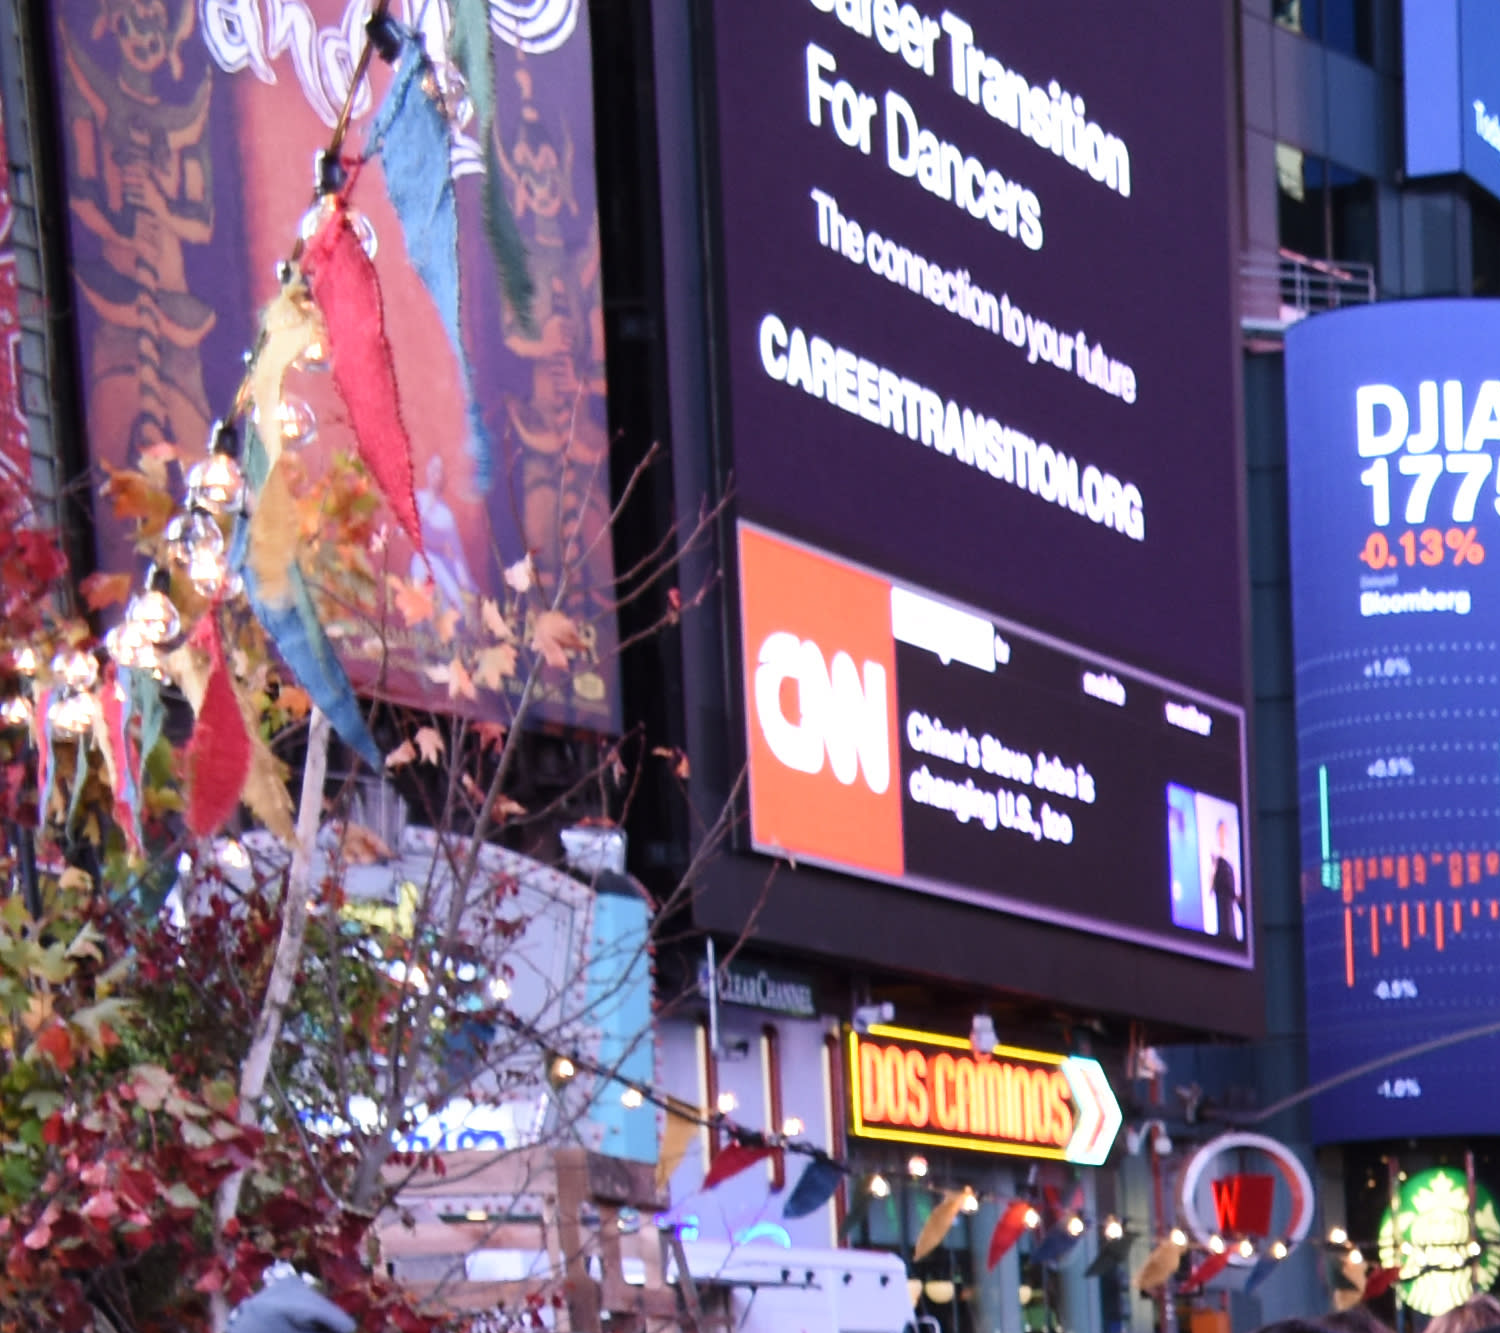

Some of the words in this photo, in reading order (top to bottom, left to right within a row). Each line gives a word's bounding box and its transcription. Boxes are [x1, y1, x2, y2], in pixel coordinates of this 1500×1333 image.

[806, 42, 877, 155] For
[886, 89, 1044, 251] Dancers
[810, 0, 940, 77] areer
[941, 9, 1131, 198] Transition
[811, 187, 865, 265] The
[866, 227, 1000, 334] connection
[1000, 293, 1025, 349] to
[1025, 315, 1077, 365] your
[1075, 330, 1137, 404] future
[758, 313, 1145, 541] CAREERTRANSITION.ORG
[1359, 526, 1485, 571] -0.13%
[1360, 587, 1472, 617] Bloomberg
[755, 631, 891, 795] CNN
[906, 710, 980, 769] China's
[909, 764, 998, 832] changing
[1041, 802, 1074, 845] too
[860, 1041, 930, 1128] DOS
